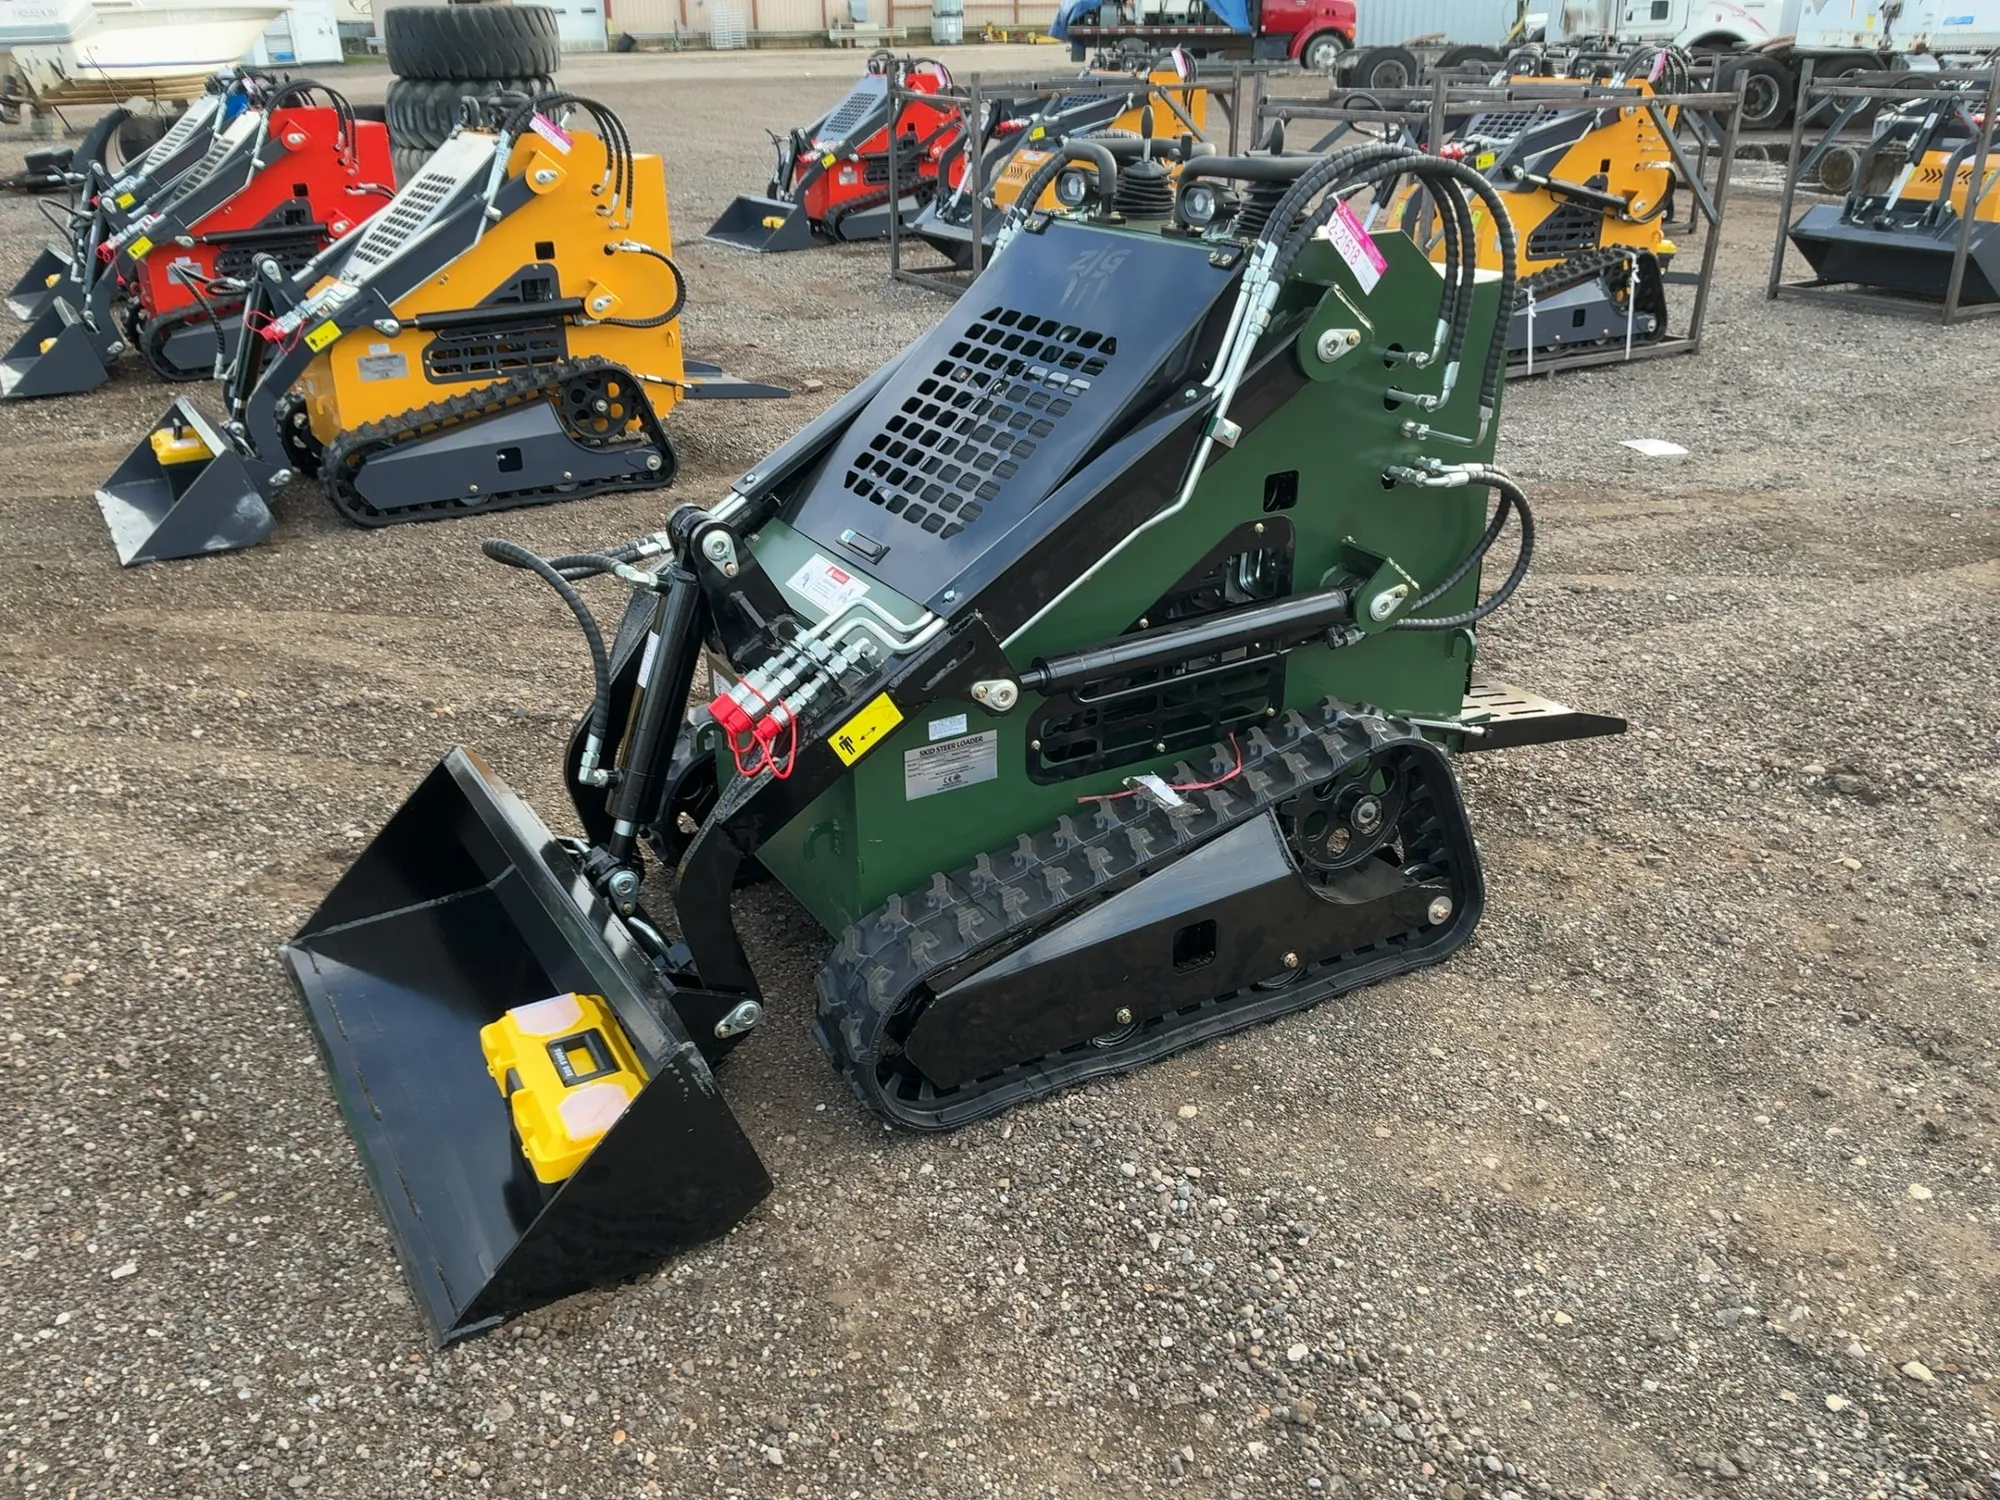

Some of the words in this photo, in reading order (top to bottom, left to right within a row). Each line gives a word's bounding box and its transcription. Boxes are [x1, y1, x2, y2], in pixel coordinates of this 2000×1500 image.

[1328, 218, 1361, 266] 2-21618
[919, 747, 936, 756] SKID
[936, 742, 956, 754] STEER
[957, 735, 984, 748] LOADER
